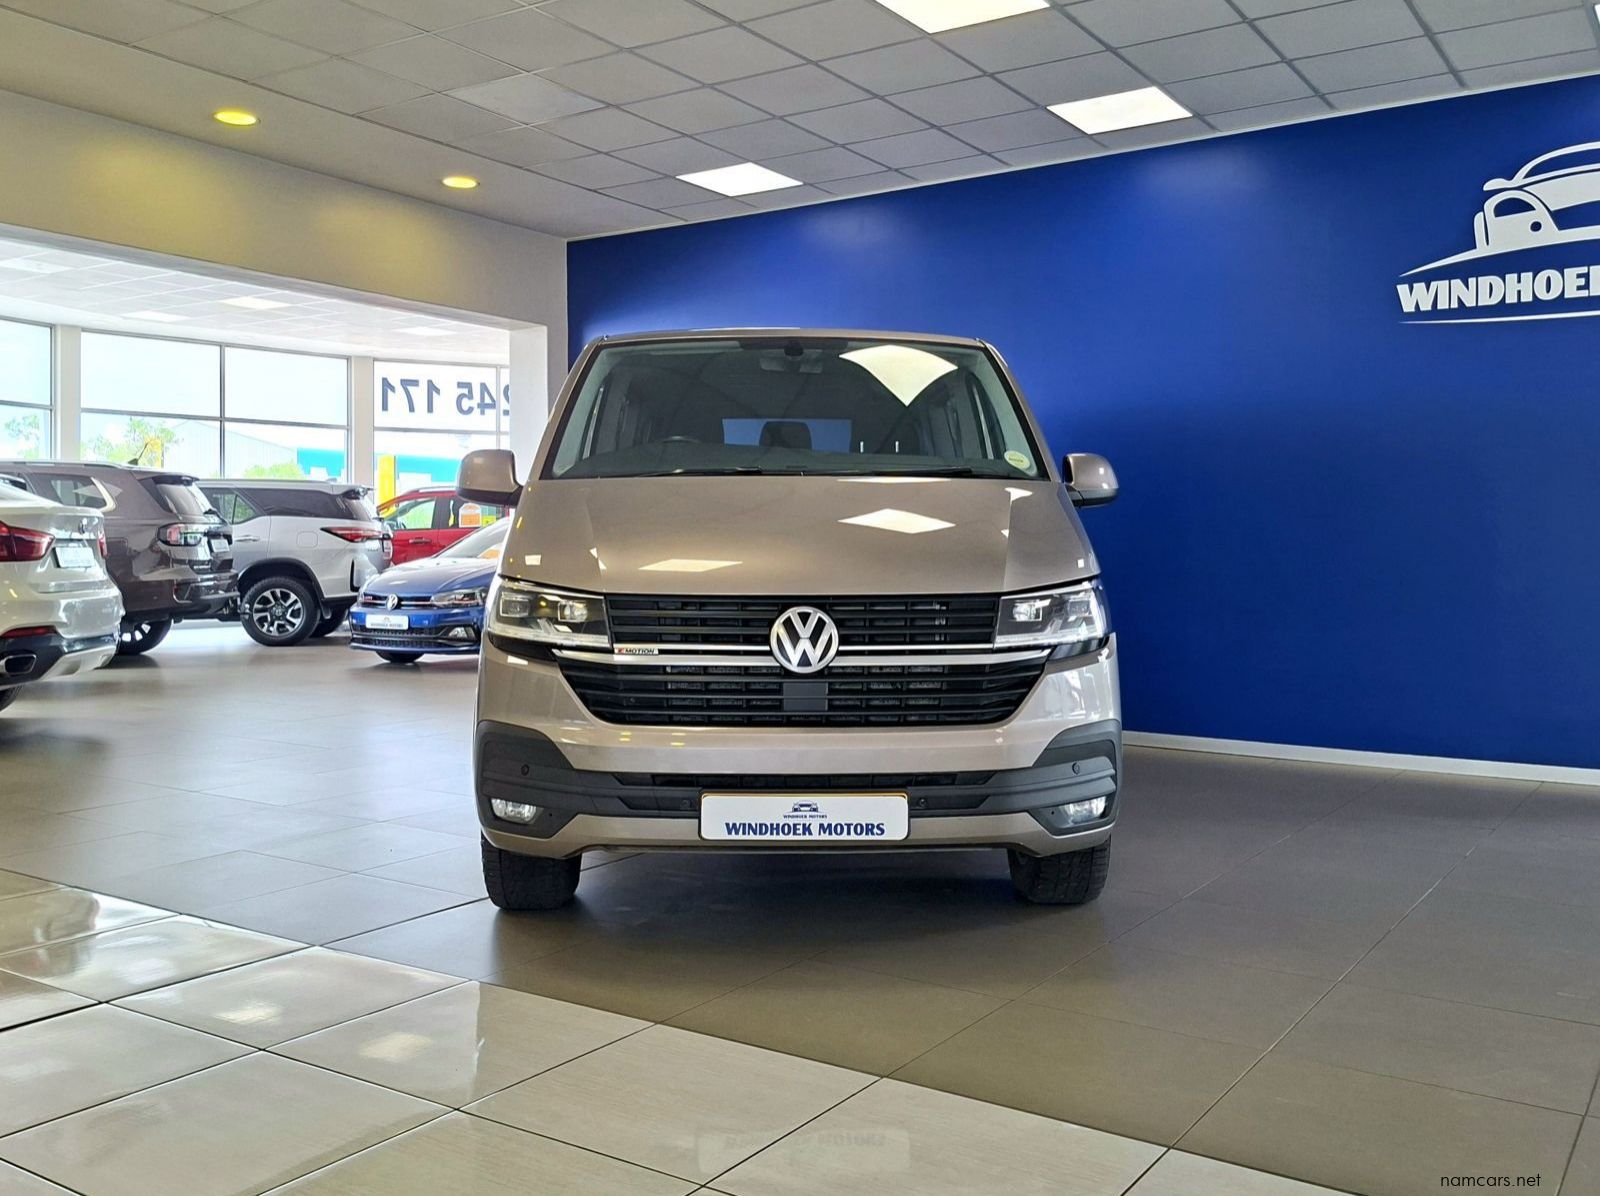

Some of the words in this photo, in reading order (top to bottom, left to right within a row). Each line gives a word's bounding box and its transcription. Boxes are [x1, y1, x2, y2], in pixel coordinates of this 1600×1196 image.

[771, 606, 838, 673] VW
[725, 822, 814, 836] WINDHOEK
[818, 822, 885, 836] MOTORS
